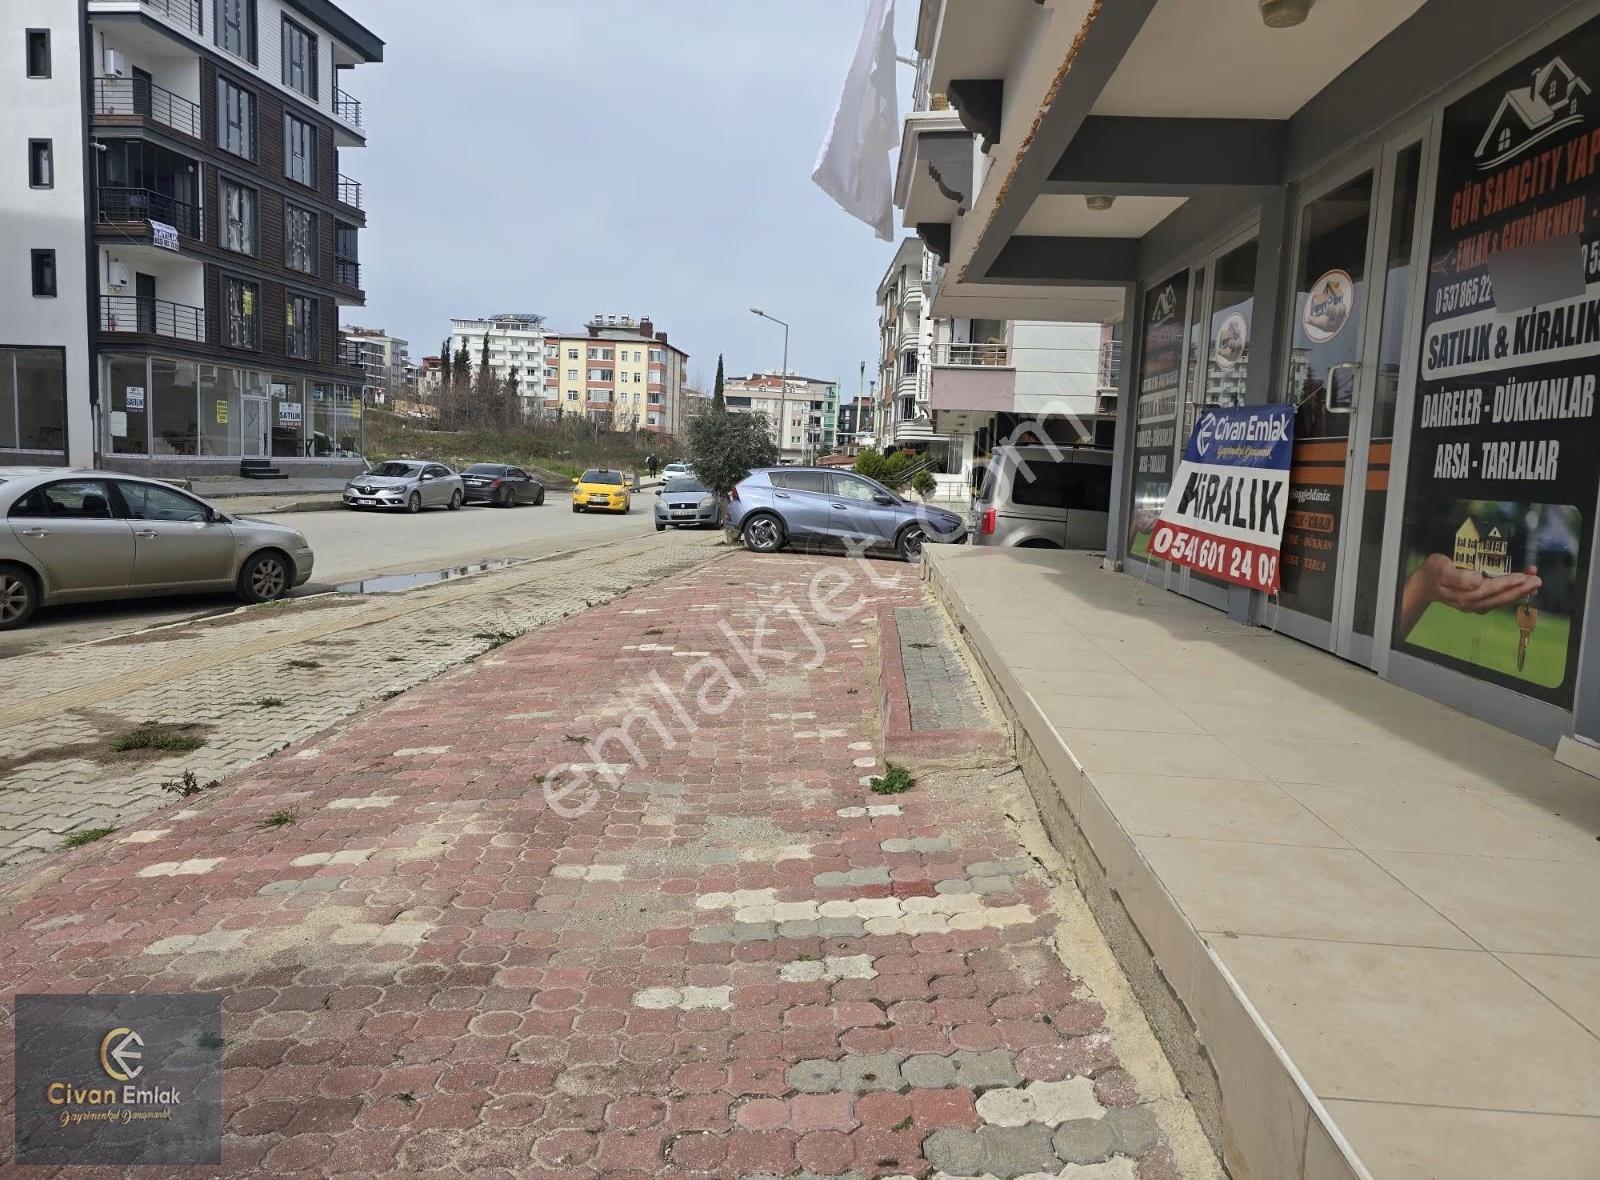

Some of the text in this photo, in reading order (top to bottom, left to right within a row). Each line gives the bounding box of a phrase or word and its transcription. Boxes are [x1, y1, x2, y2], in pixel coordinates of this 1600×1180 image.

[1451, 180, 1482, 229] GÜR
[1427, 299, 1600, 371] SATILIK & KİRALIK
[279, 411, 301, 420] SATILIK
[1421, 386, 1483, 429] DAİRELER
[1492, 373, 1596, 424] DÜKKANLAR
[1214, 415, 1246, 441] Civan
[1246, 413, 1290, 441] Emlak
[1433, 443, 1470, 479] ARSA
[1481, 440, 1560, 481] TARLALAR
[1199, 539, 1226, 573] 601
[1229, 547, 1253, 581] 24
[1258, 553, 1277, 587] 09
